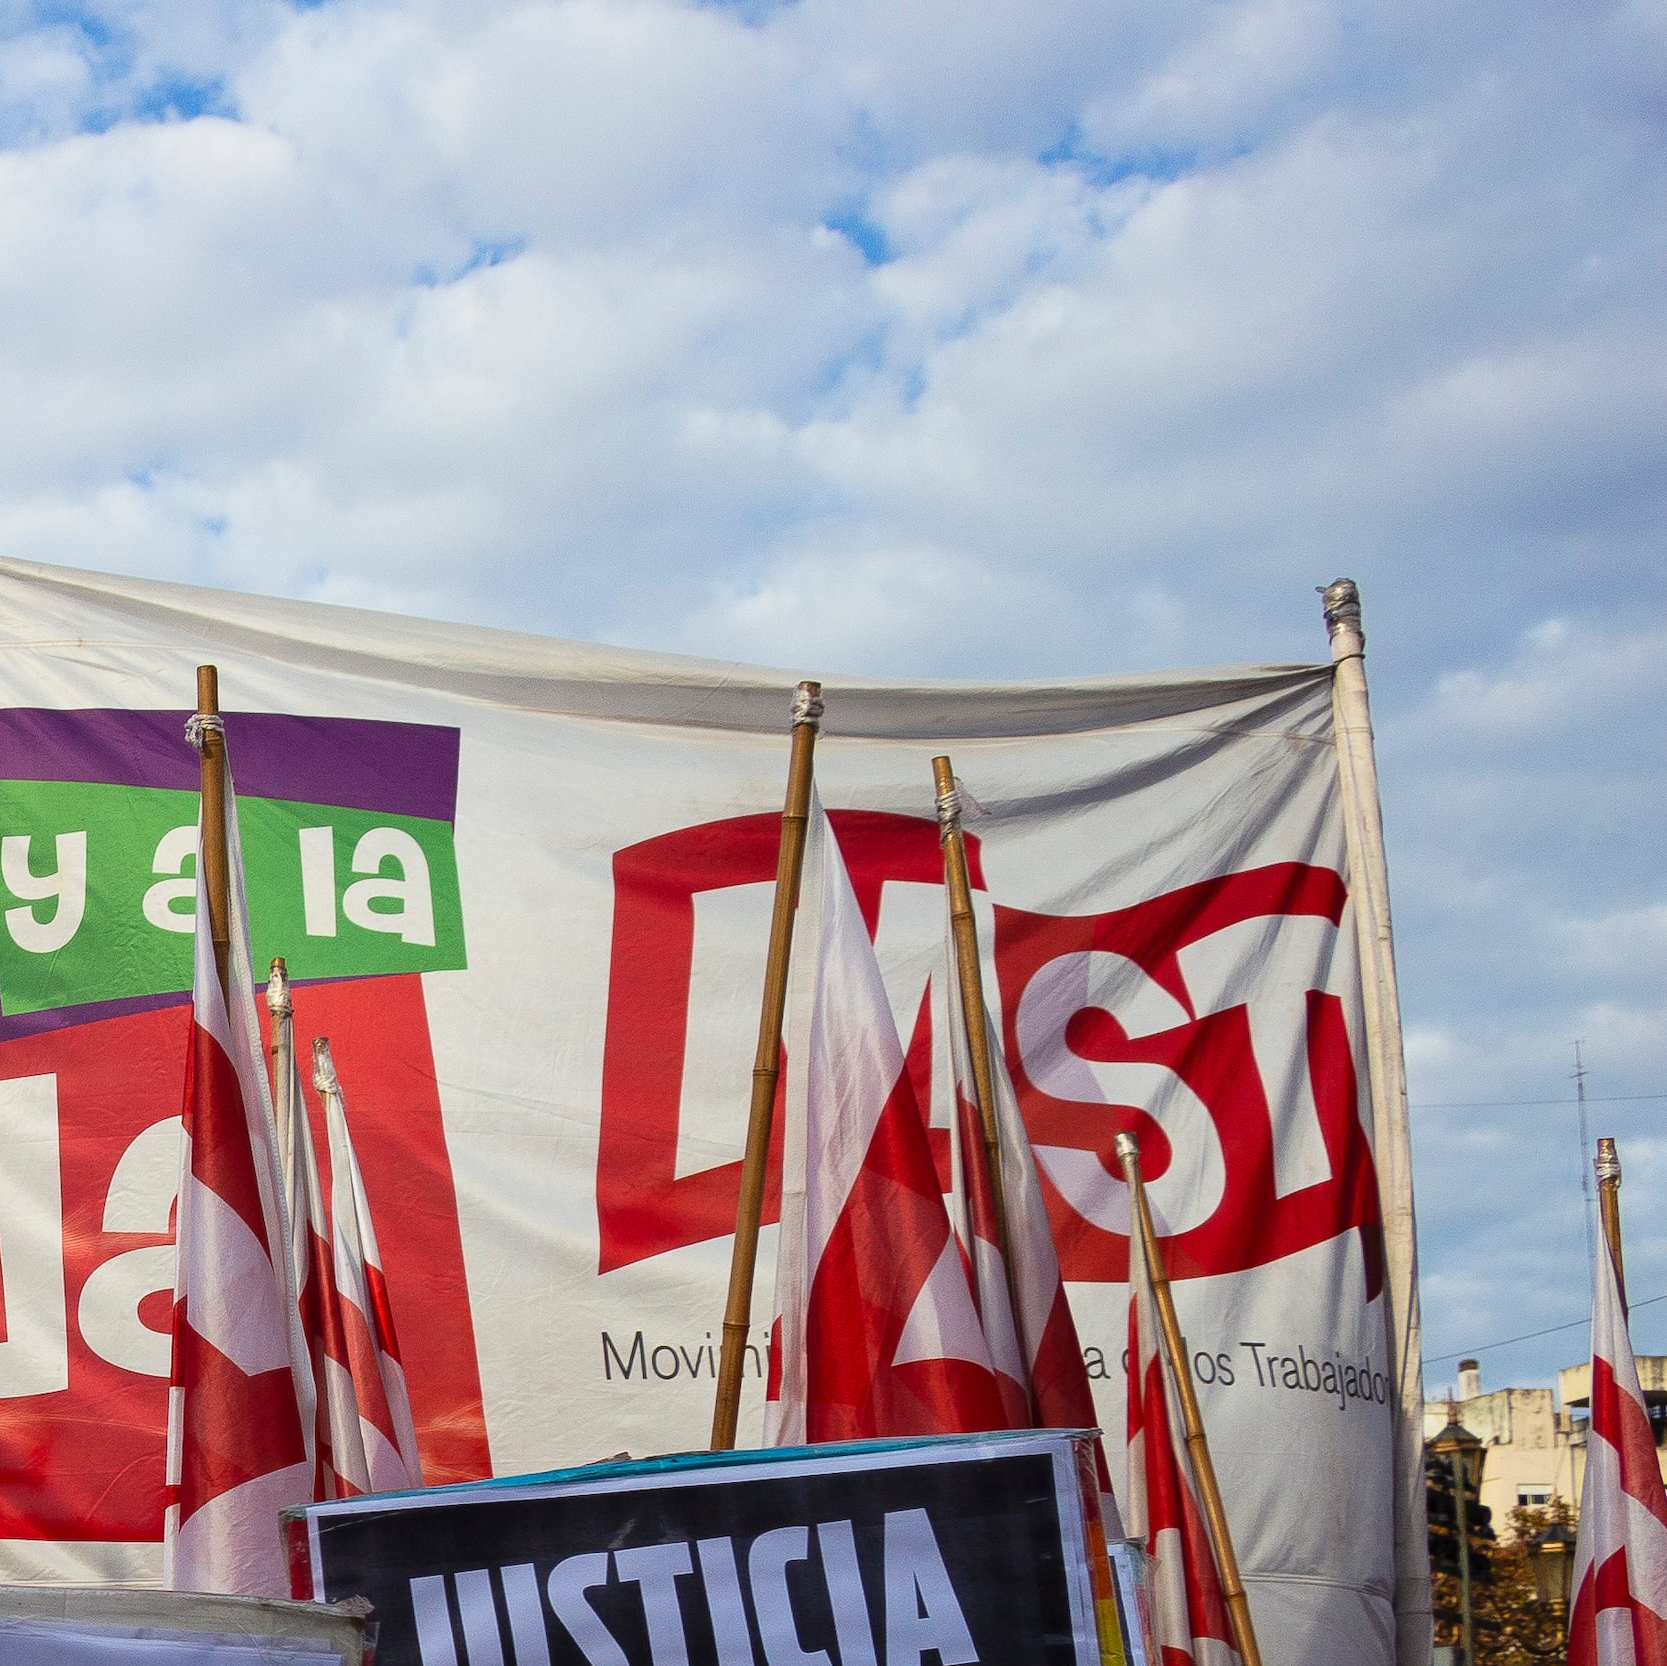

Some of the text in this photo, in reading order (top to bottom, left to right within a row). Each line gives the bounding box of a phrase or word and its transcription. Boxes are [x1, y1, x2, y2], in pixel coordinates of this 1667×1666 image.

[0, 830, 87, 954] y
[299, 825, 437, 948] la
[1240, 1341, 1387, 1411] Trabajado
